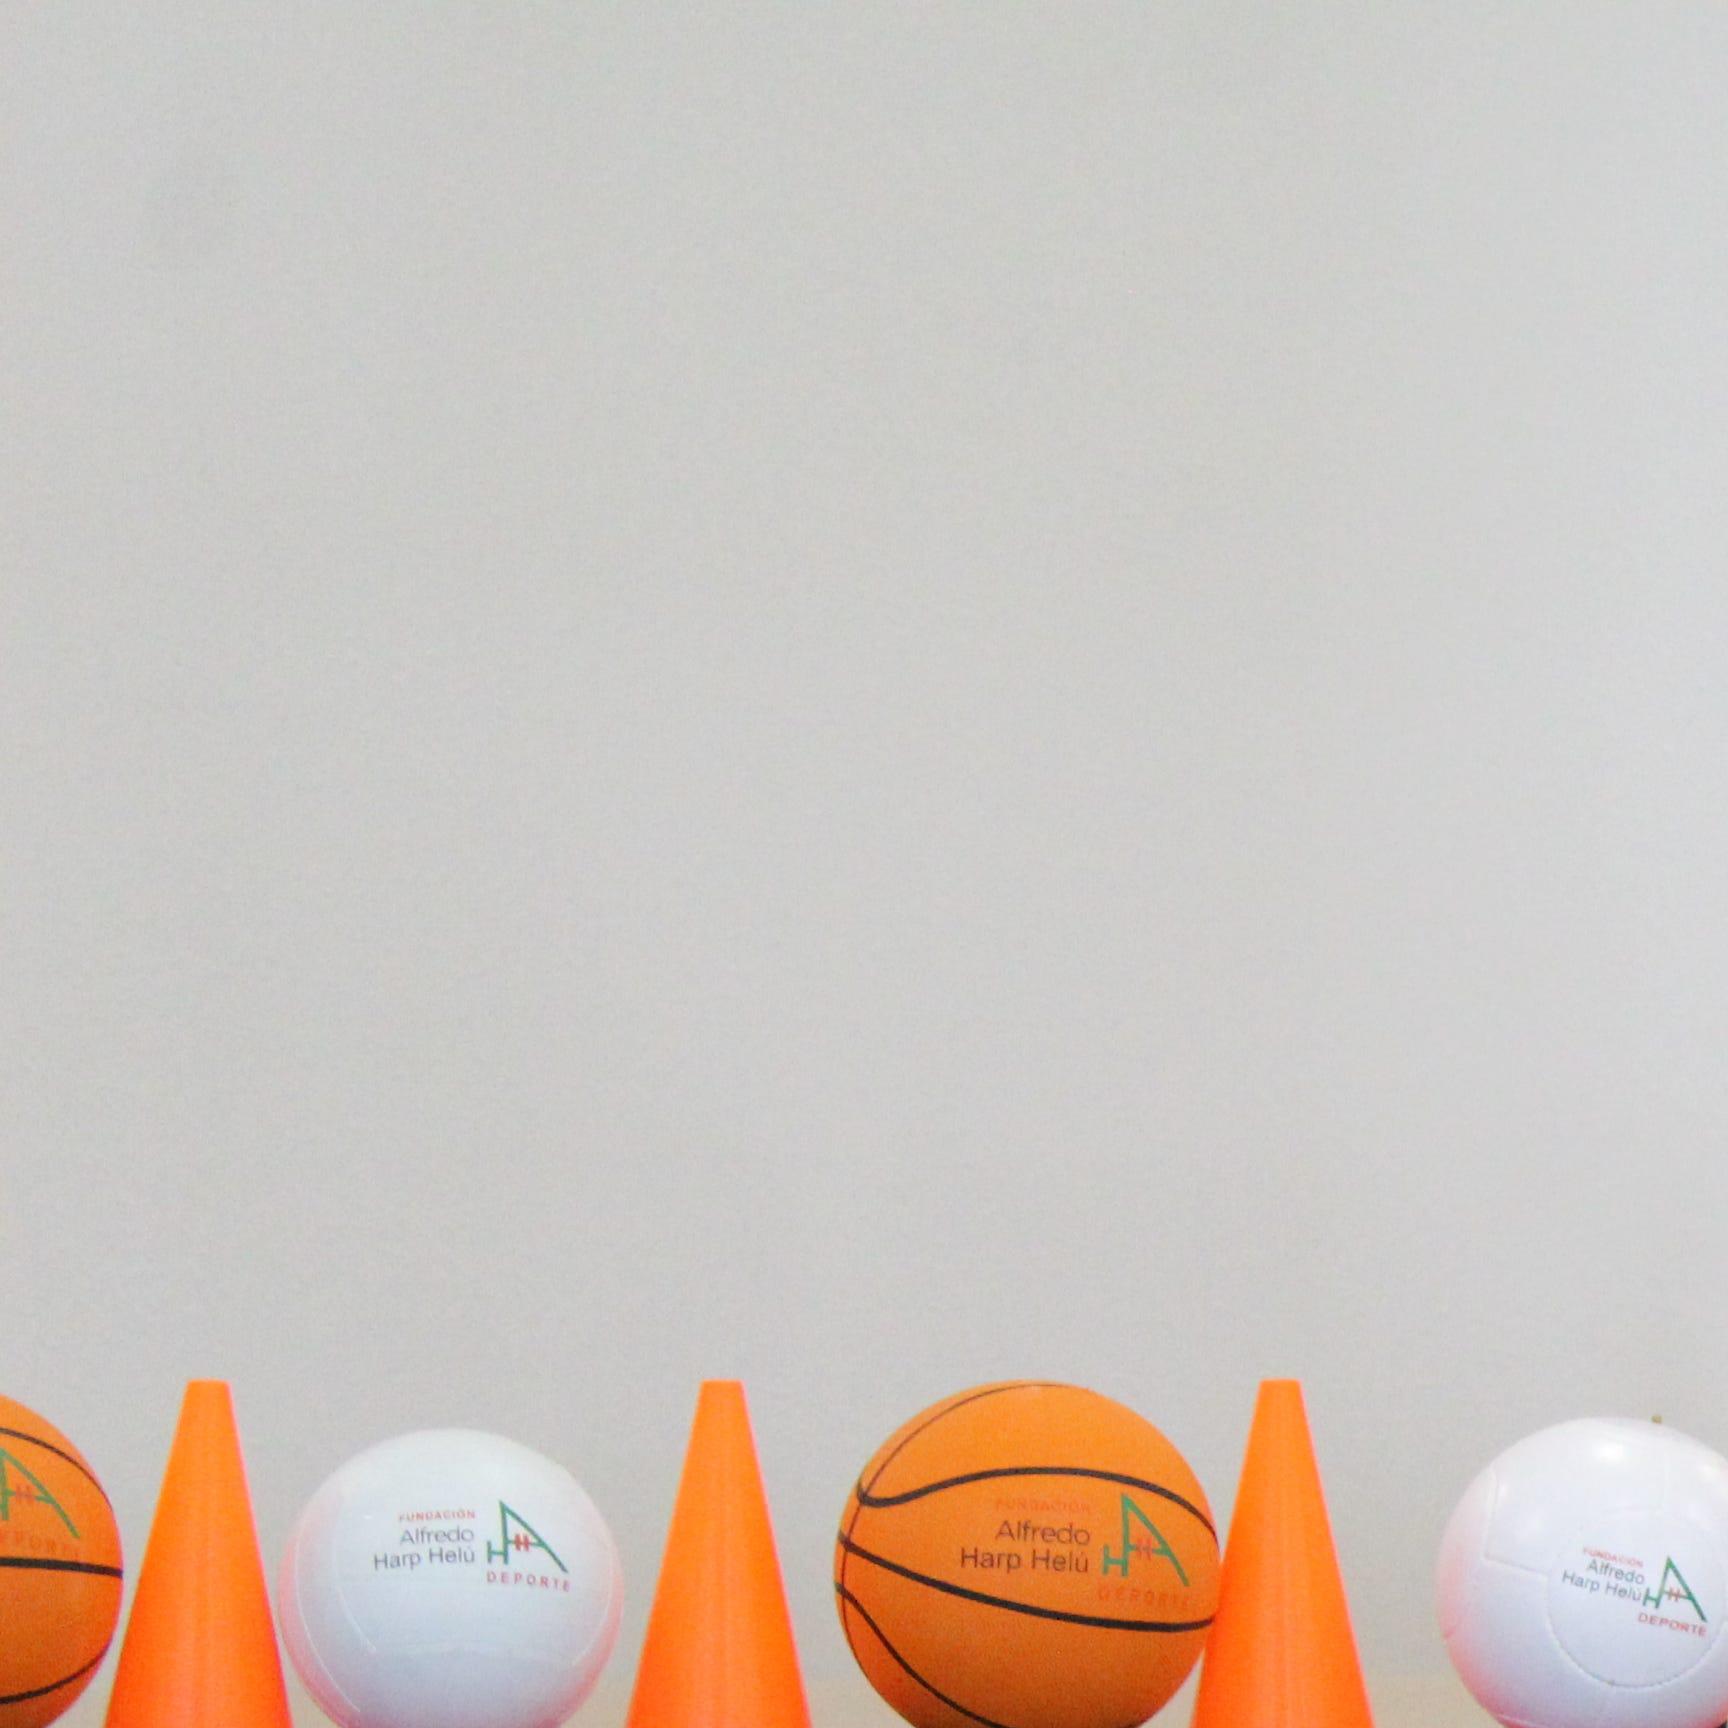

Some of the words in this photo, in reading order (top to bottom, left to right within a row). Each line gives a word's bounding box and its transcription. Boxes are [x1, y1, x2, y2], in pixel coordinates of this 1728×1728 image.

[400, 1526, 474, 1545] Alfredo
[995, 1520, 1090, 1544] Alfredo
[374, 1552, 420, 1570] Harp
[430, 1547, 475, 1563] Helú
[960, 1548, 1021, 1573] Harp
[1031, 1551, 1089, 1573] Helú
[487, 1571, 570, 1592] DEPORTE
[1586, 1559, 1645, 1585] Alfredo
[1562, 1570, 1600, 1592] Harp
[1606, 1584, 1641, 1602] Helú
[1638, 1612, 1706, 1637] DEPORTE
